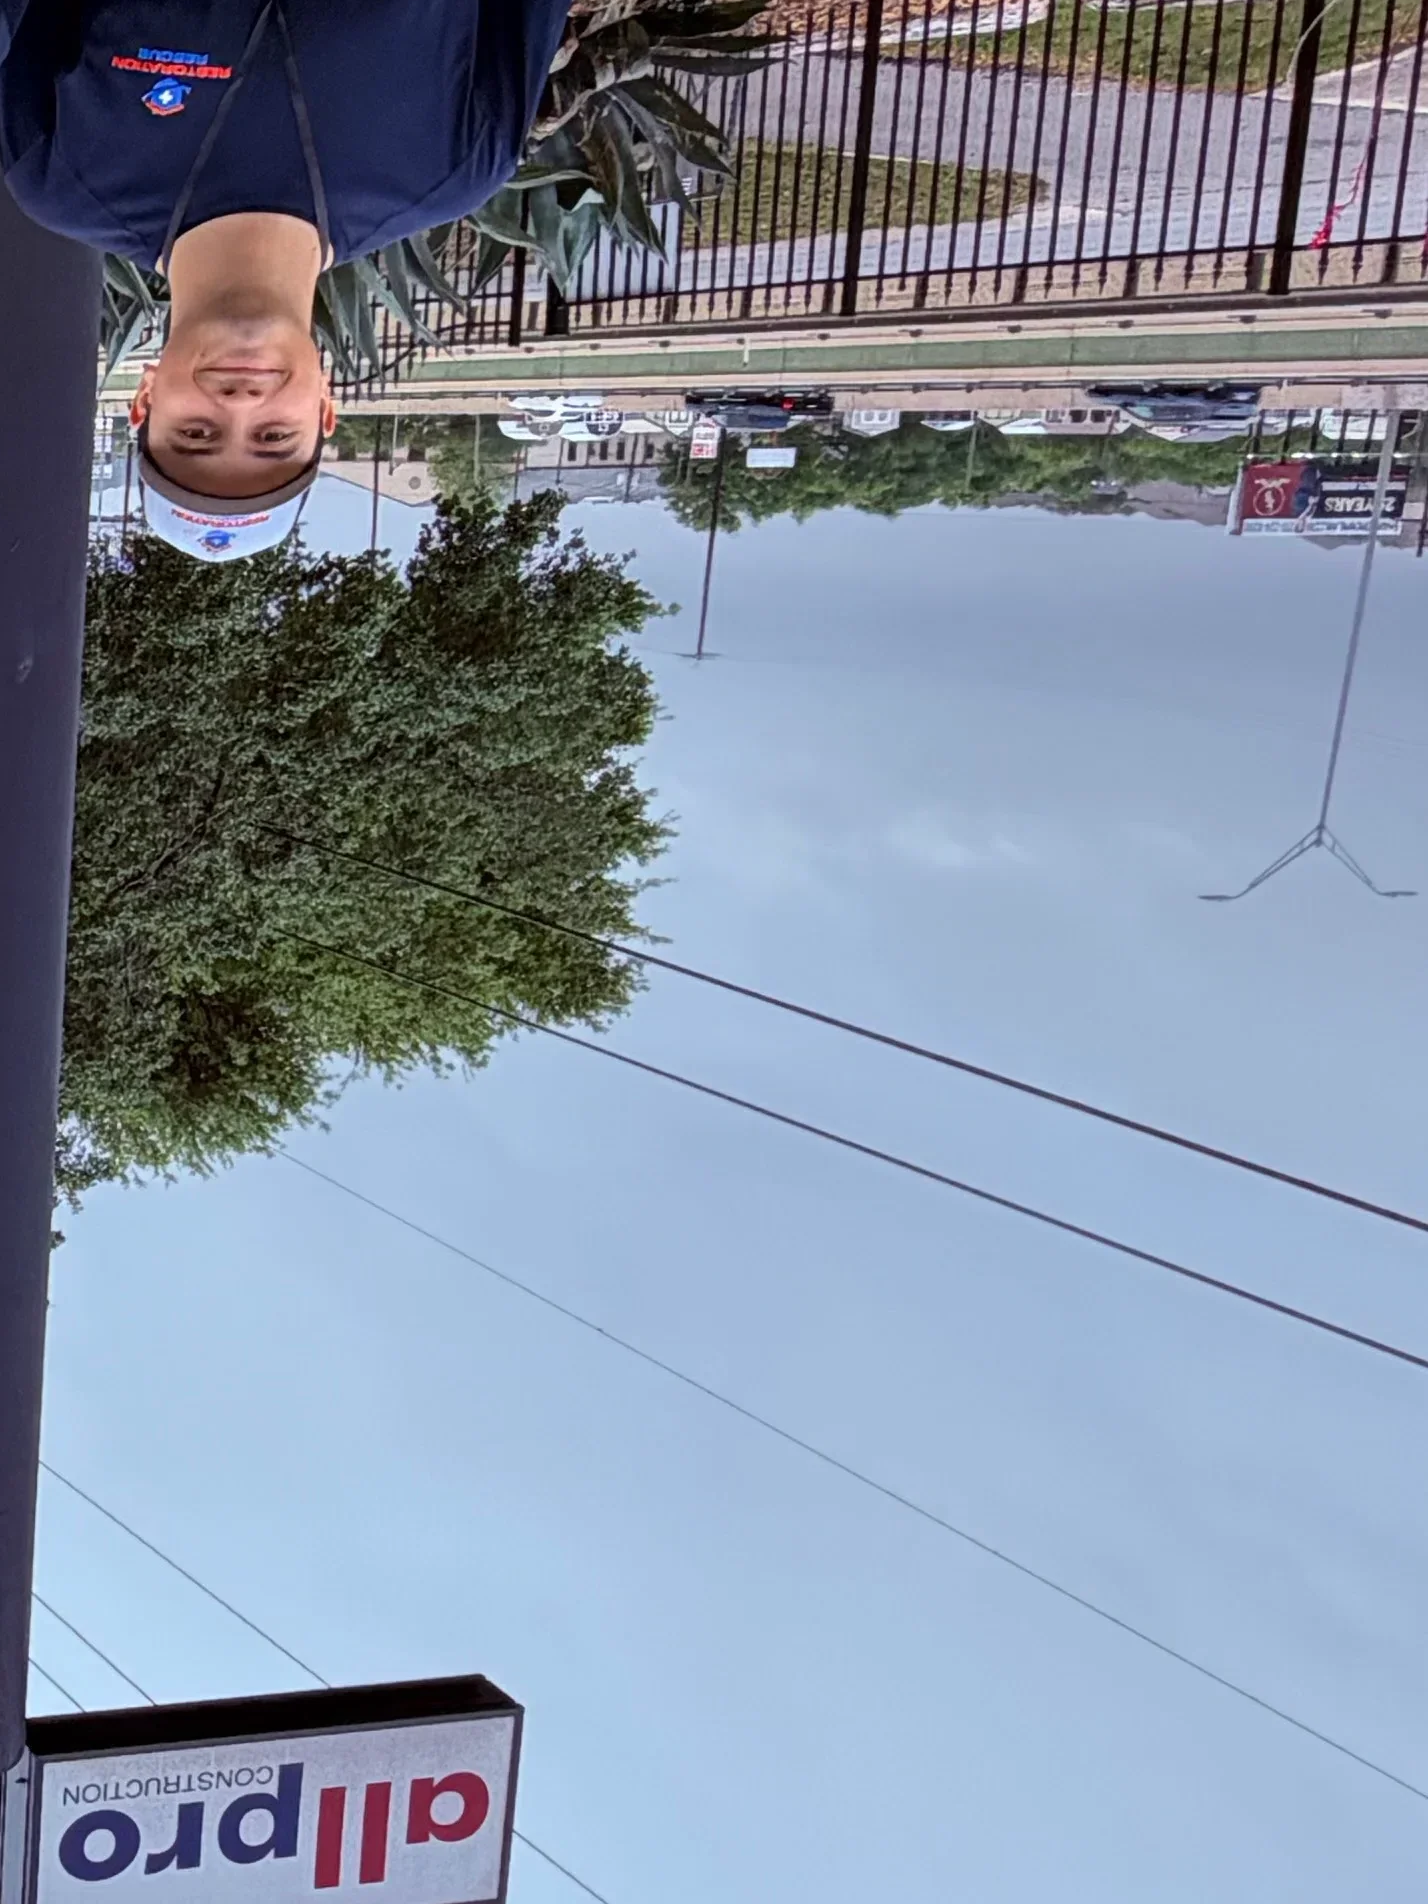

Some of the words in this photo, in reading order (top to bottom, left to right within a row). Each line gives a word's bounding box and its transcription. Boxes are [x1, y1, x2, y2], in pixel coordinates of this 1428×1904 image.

[110, 56, 232, 79] RESTORATION
[137, 47, 209, 65] RESCUE
[62, 1764, 274, 1807] CONSTRUCTION
[57, 1761, 490, 1890] allpro
